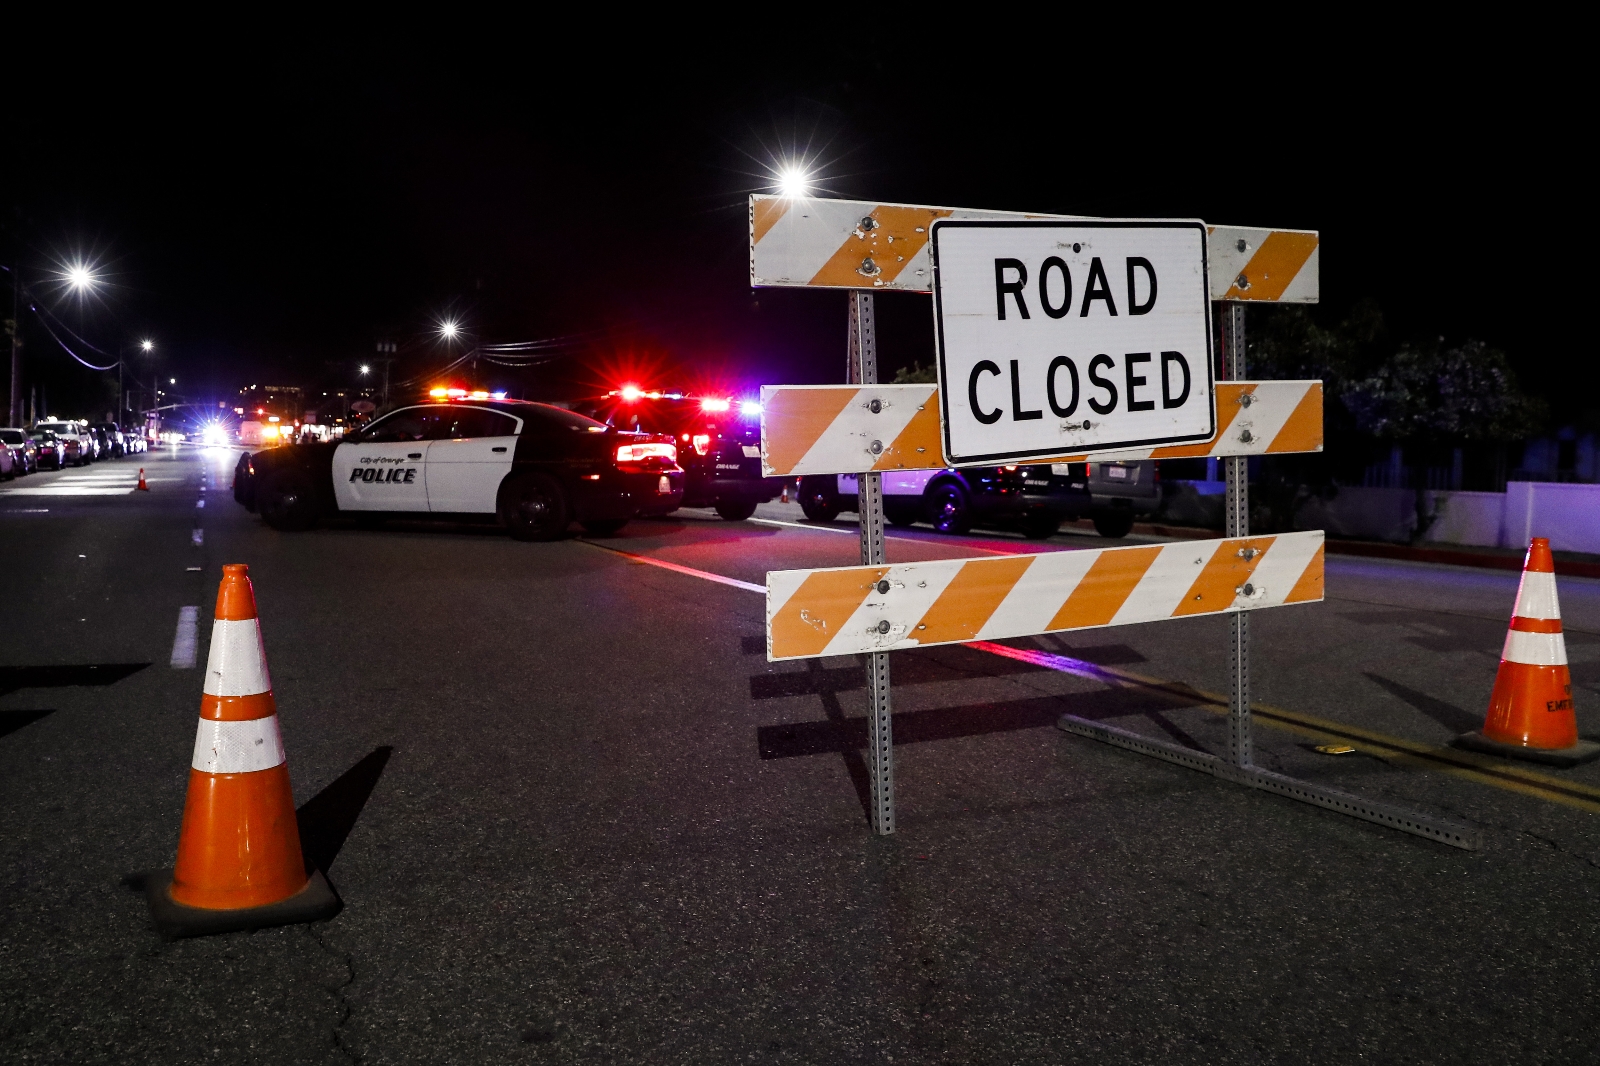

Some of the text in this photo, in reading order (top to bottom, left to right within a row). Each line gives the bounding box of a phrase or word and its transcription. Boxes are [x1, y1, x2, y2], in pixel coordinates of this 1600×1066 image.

[994, 255, 1158, 321] ROAD
[967, 350, 1191, 425] CLOSED
[349, 468, 417, 483] POLICE
[381, 457, 404, 465] Orange
